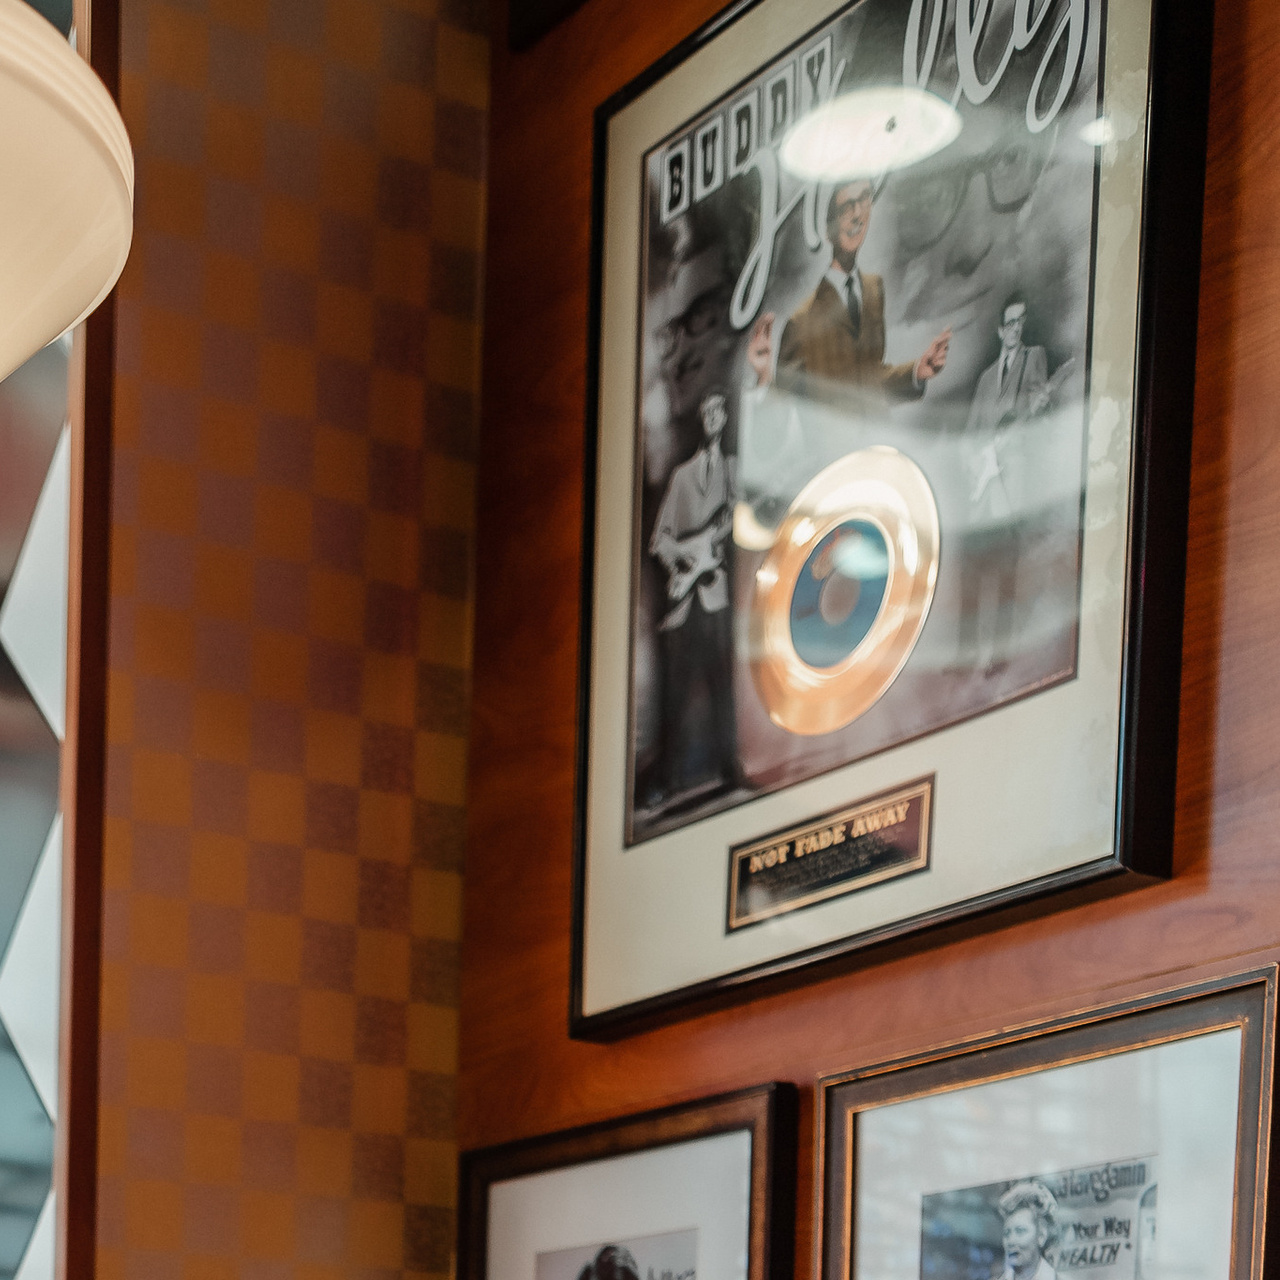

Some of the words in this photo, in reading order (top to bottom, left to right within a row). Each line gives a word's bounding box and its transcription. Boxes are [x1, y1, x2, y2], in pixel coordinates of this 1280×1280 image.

[663, 38, 830, 218] BUDDY
[749, 844, 790, 874] NOT
[793, 824, 846, 858] FADE
[851, 802, 911, 838] AWAY
[1103, 1216, 1131, 1239] Way
